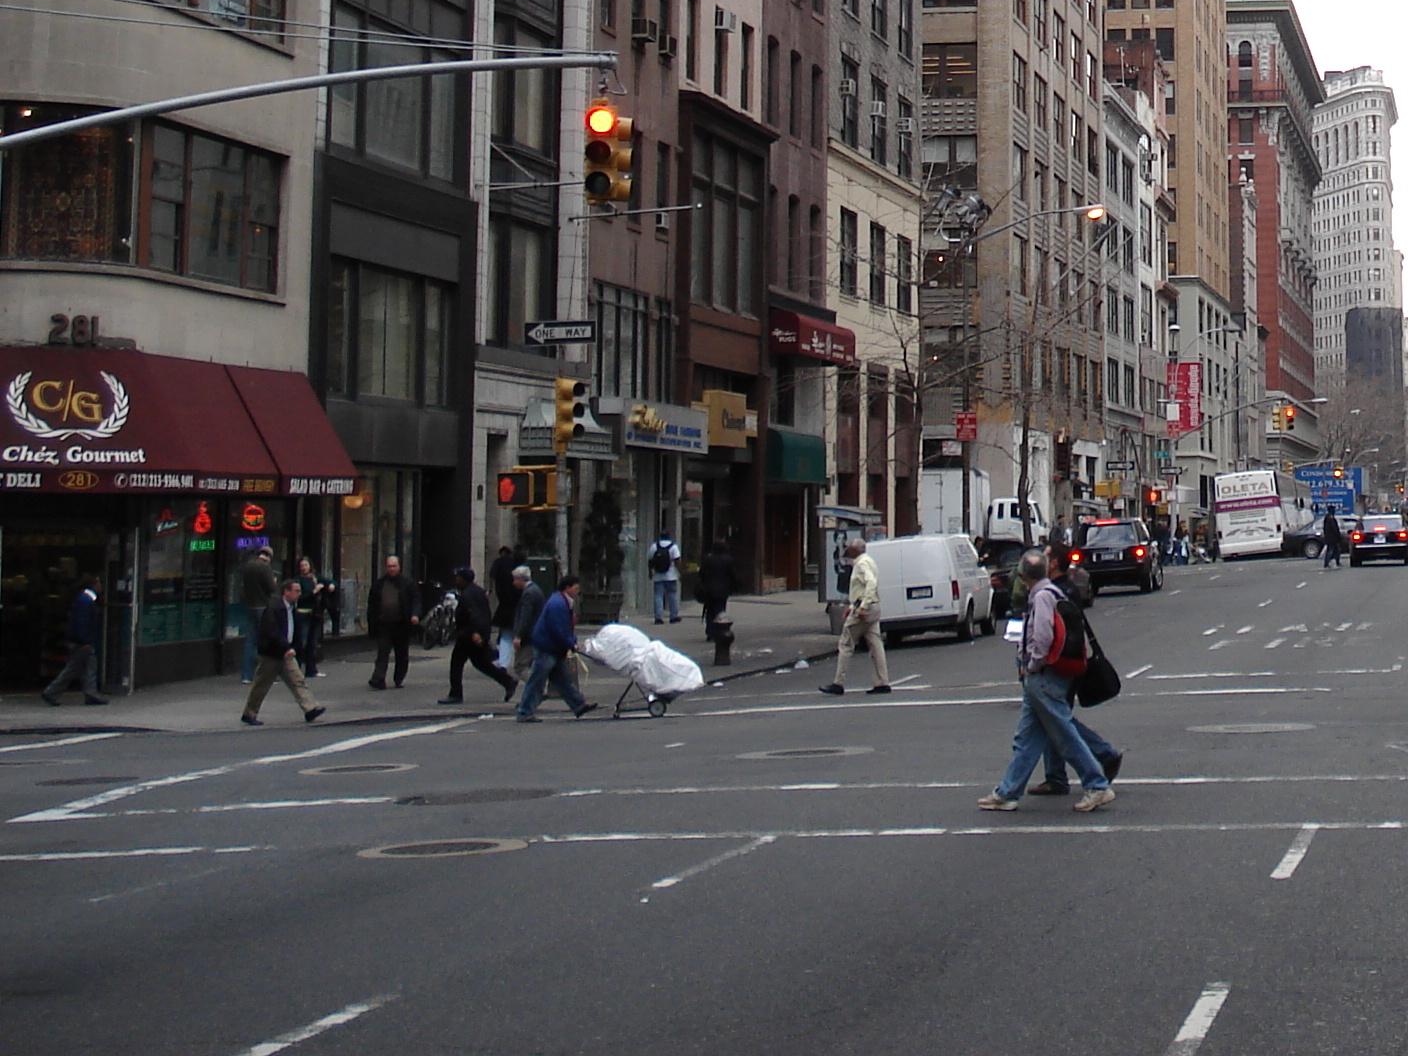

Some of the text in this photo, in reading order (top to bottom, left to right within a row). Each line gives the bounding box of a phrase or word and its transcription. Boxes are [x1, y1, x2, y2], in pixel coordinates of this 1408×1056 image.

[49, 313, 100, 346] 281
[535, 327, 588, 339] ONE WAY
[66, 446, 147, 463] Gourmet
[6, 473, 43, 488] DELI
[66, 473, 92, 488] 281
[1220, 482, 1268, 495] OLETA
